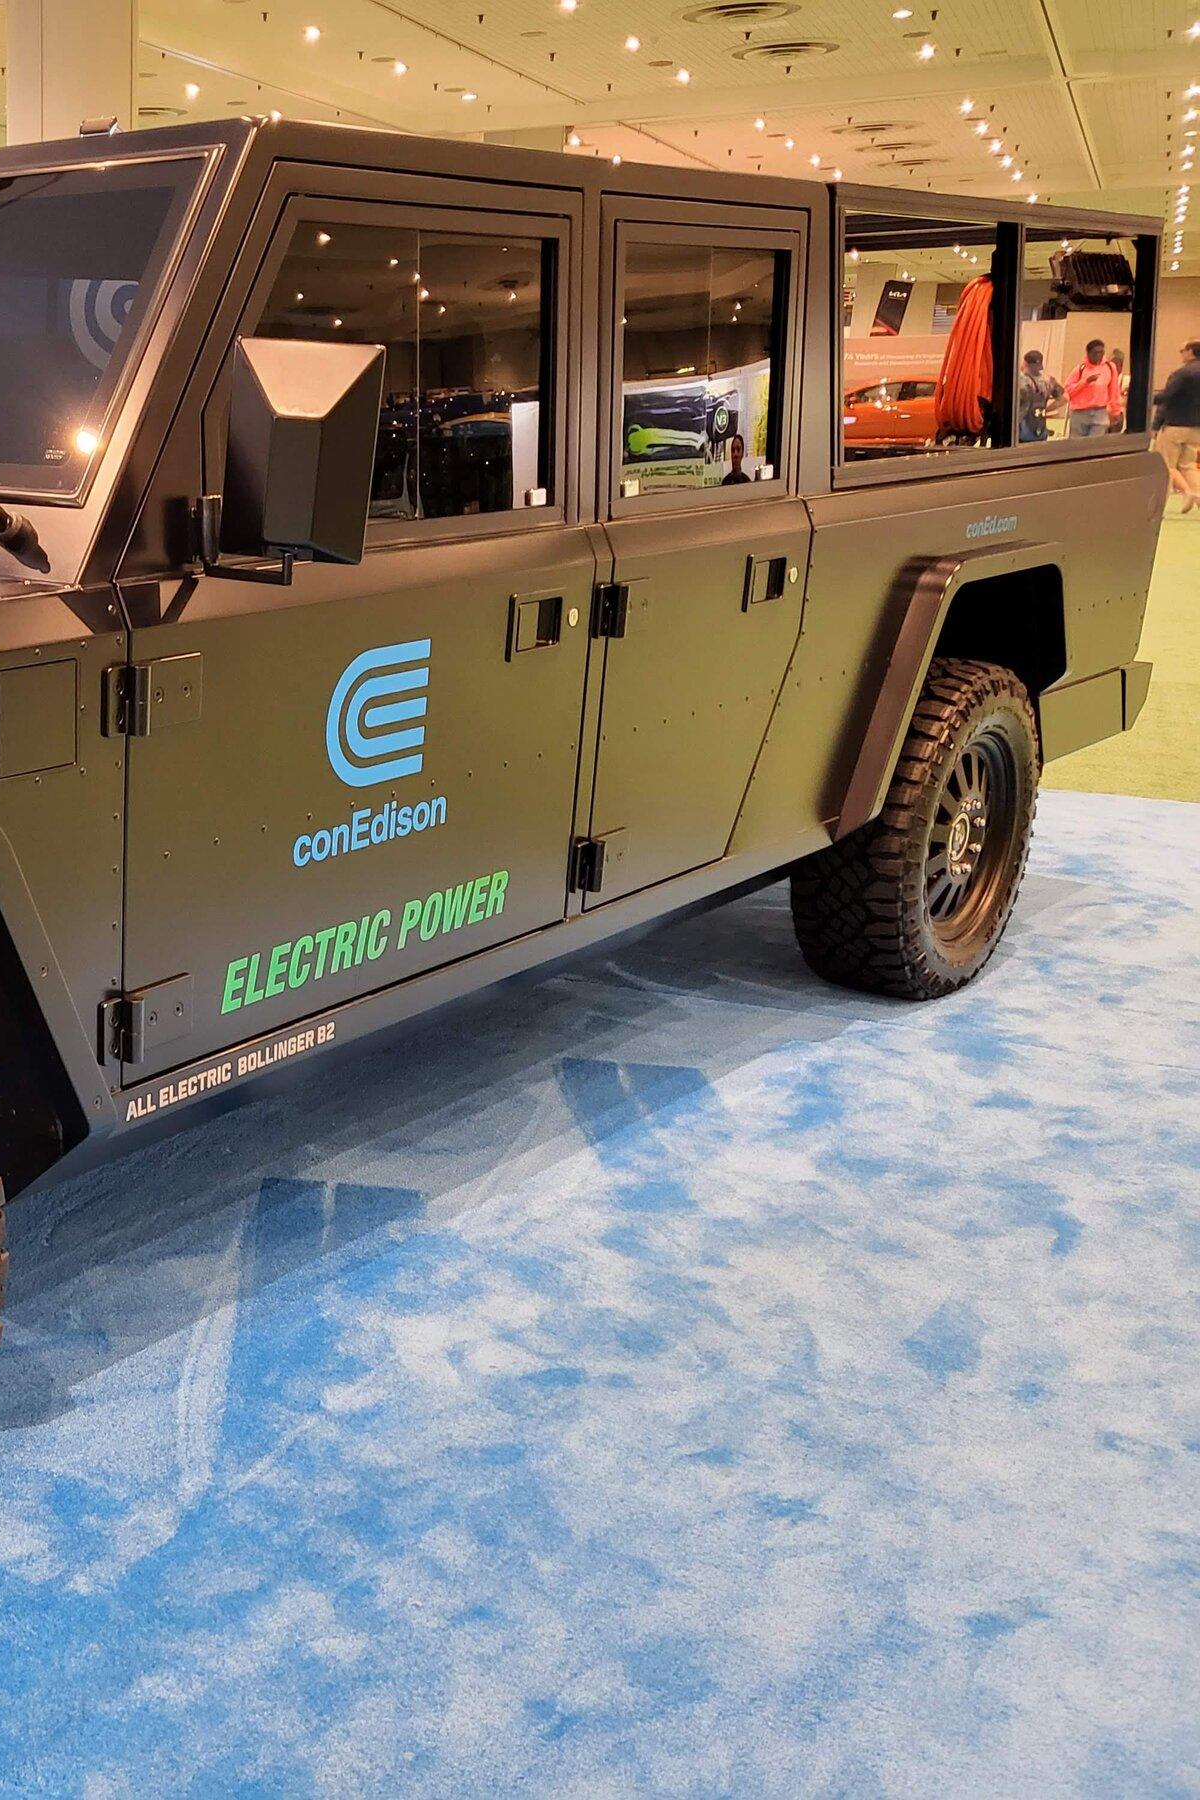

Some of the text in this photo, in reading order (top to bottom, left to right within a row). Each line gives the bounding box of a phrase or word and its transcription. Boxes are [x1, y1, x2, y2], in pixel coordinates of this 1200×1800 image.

[965, 515, 1017, 539] conEd.com
[293, 796, 447, 867] conEdison
[221, 870, 509, 1014] ELECTRIC POWER
[125, 1021, 335, 1122] ALL ELECTRIC BOLLINGER B2
